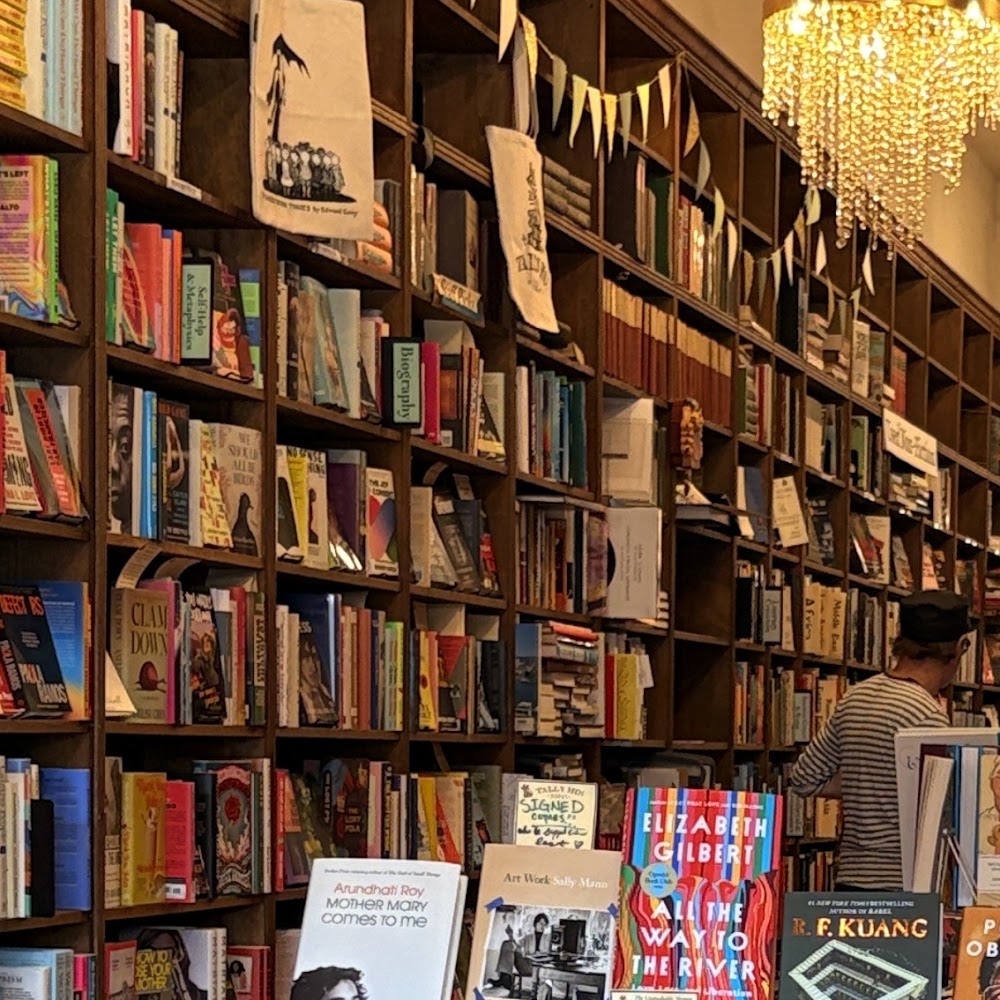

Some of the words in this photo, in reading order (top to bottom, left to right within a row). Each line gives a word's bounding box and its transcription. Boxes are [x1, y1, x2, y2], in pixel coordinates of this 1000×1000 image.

[397, 346, 414, 420] Biography
[520, 799, 584, 814] SIGNED
[643, 813, 767, 839] ELIZABETH
[653, 841, 753, 865] GILBERT
[503, 873, 521, 883] Art
[524, 874, 551, 884] Work
[334, 883, 398, 896] Arundhati
[401, 885, 425, 898] Roy
[652, 900, 694, 923] ALL
[707, 902, 742, 923] THE
[641, 926, 706, 949] WAY
[716, 928, 748, 950] TO
[792, 919, 811, 936] R.
[816, 919, 834, 937] F.
[838, 918, 929, 938] KUANG
[632, 955, 668, 977] THE
[679, 956, 755, 980] RIVER
